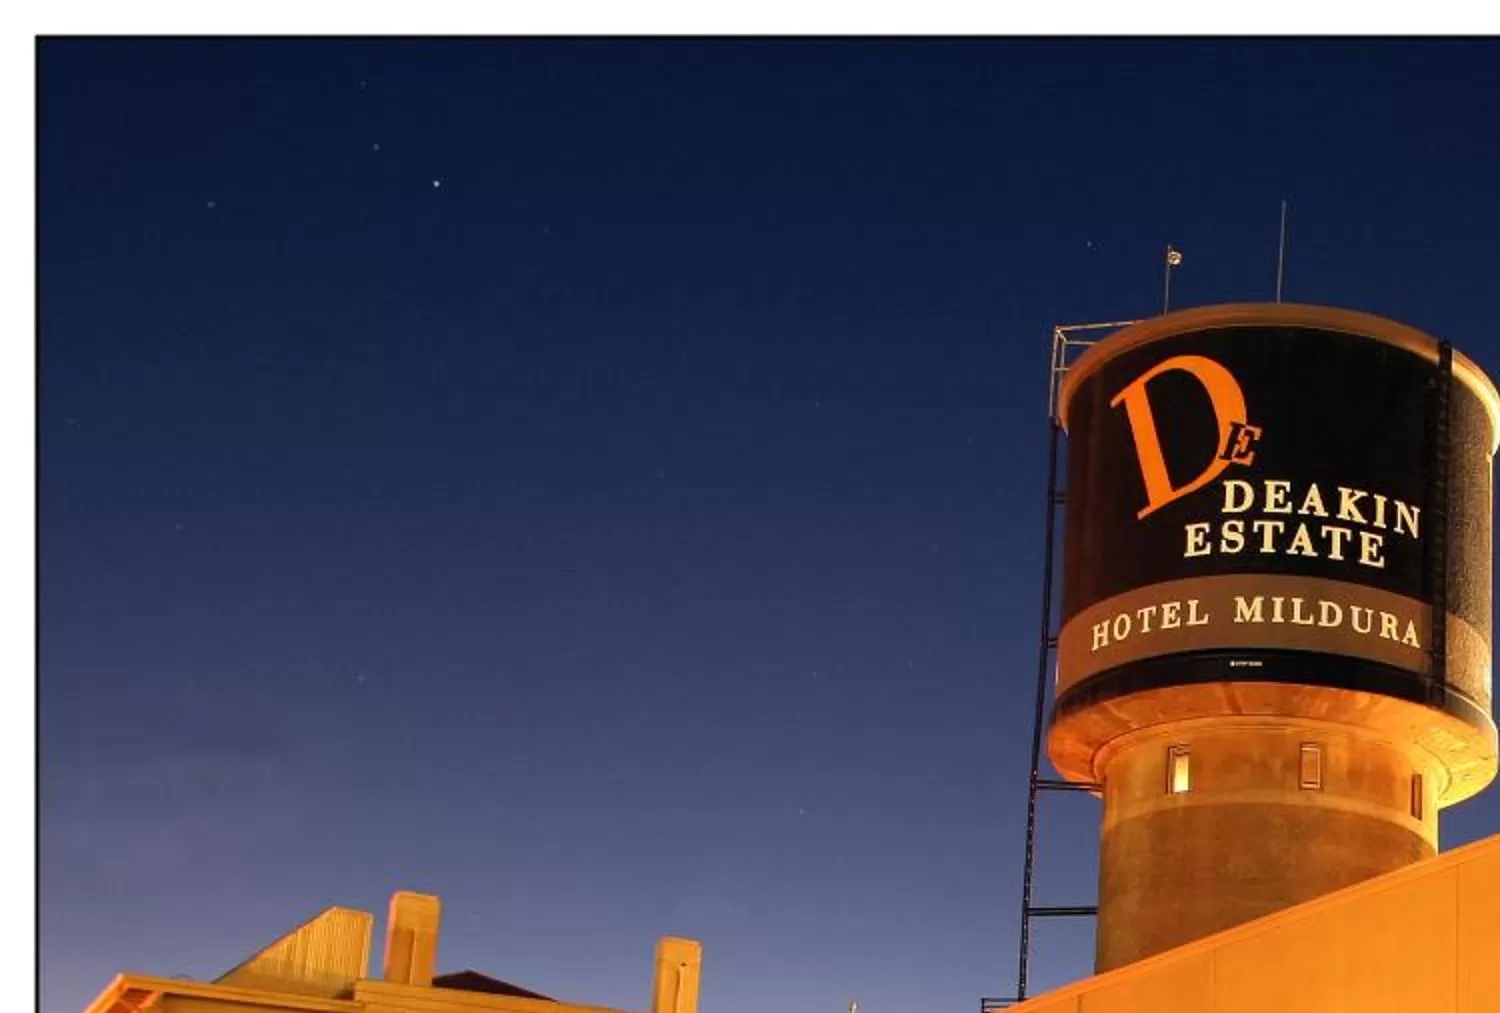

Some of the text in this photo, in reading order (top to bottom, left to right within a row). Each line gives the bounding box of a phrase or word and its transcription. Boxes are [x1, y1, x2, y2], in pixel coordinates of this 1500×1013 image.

[1221, 479, 1421, 539] DEAKIN
[1183, 520, 1386, 569] ESTATE
[1090, 596, 1422, 651] HOTEL MILDURA
